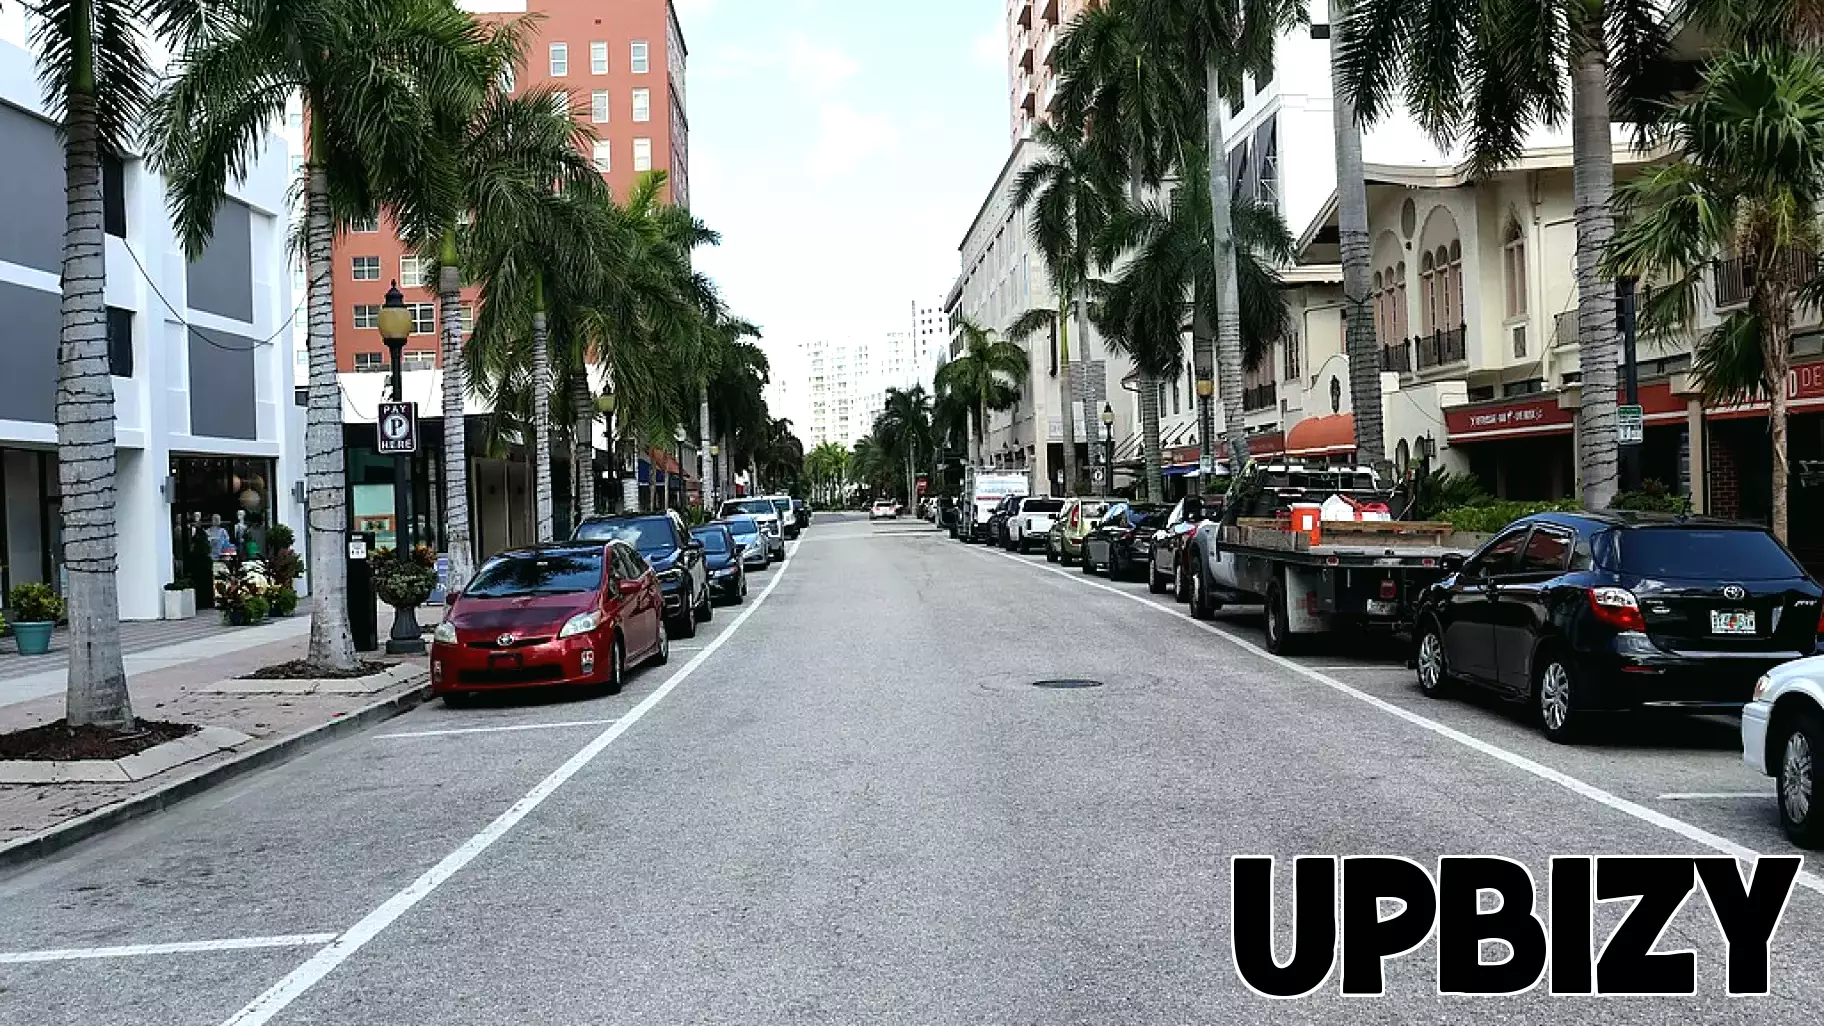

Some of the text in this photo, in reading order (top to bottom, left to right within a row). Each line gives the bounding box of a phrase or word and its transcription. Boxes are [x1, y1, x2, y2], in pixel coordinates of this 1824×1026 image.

[383, 404, 406, 414] PAY
[390, 419, 404, 436] P
[381, 439, 412, 449] HERE
